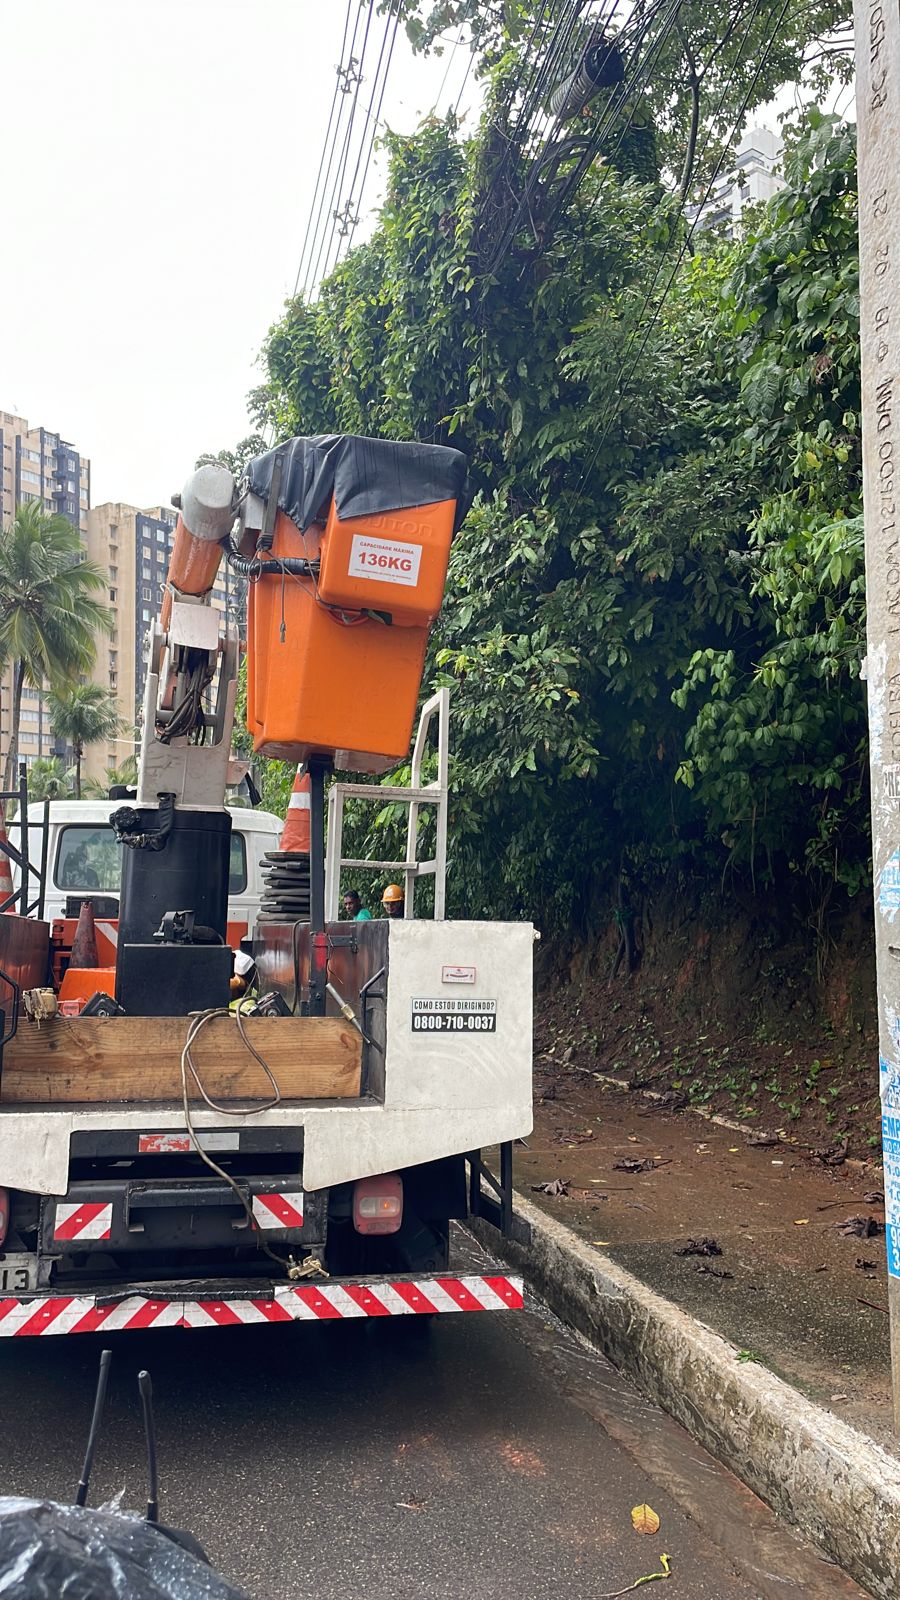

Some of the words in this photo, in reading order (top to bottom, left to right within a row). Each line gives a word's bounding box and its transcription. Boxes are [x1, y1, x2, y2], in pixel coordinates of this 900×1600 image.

[876, 378, 894, 432] DAN
[360, 541, 393, 552] CAPACIDADE
[358, 551, 412, 572] 136KG
[414, 1001, 433, 1010] COMO
[434, 1001, 456, 1010] ESTOU
[457, 1001, 495, 1011] DIRIGINDO?
[414, 1015, 494, 1029] 0800-710-0037
[2, 1270, 29, 1290] 13
